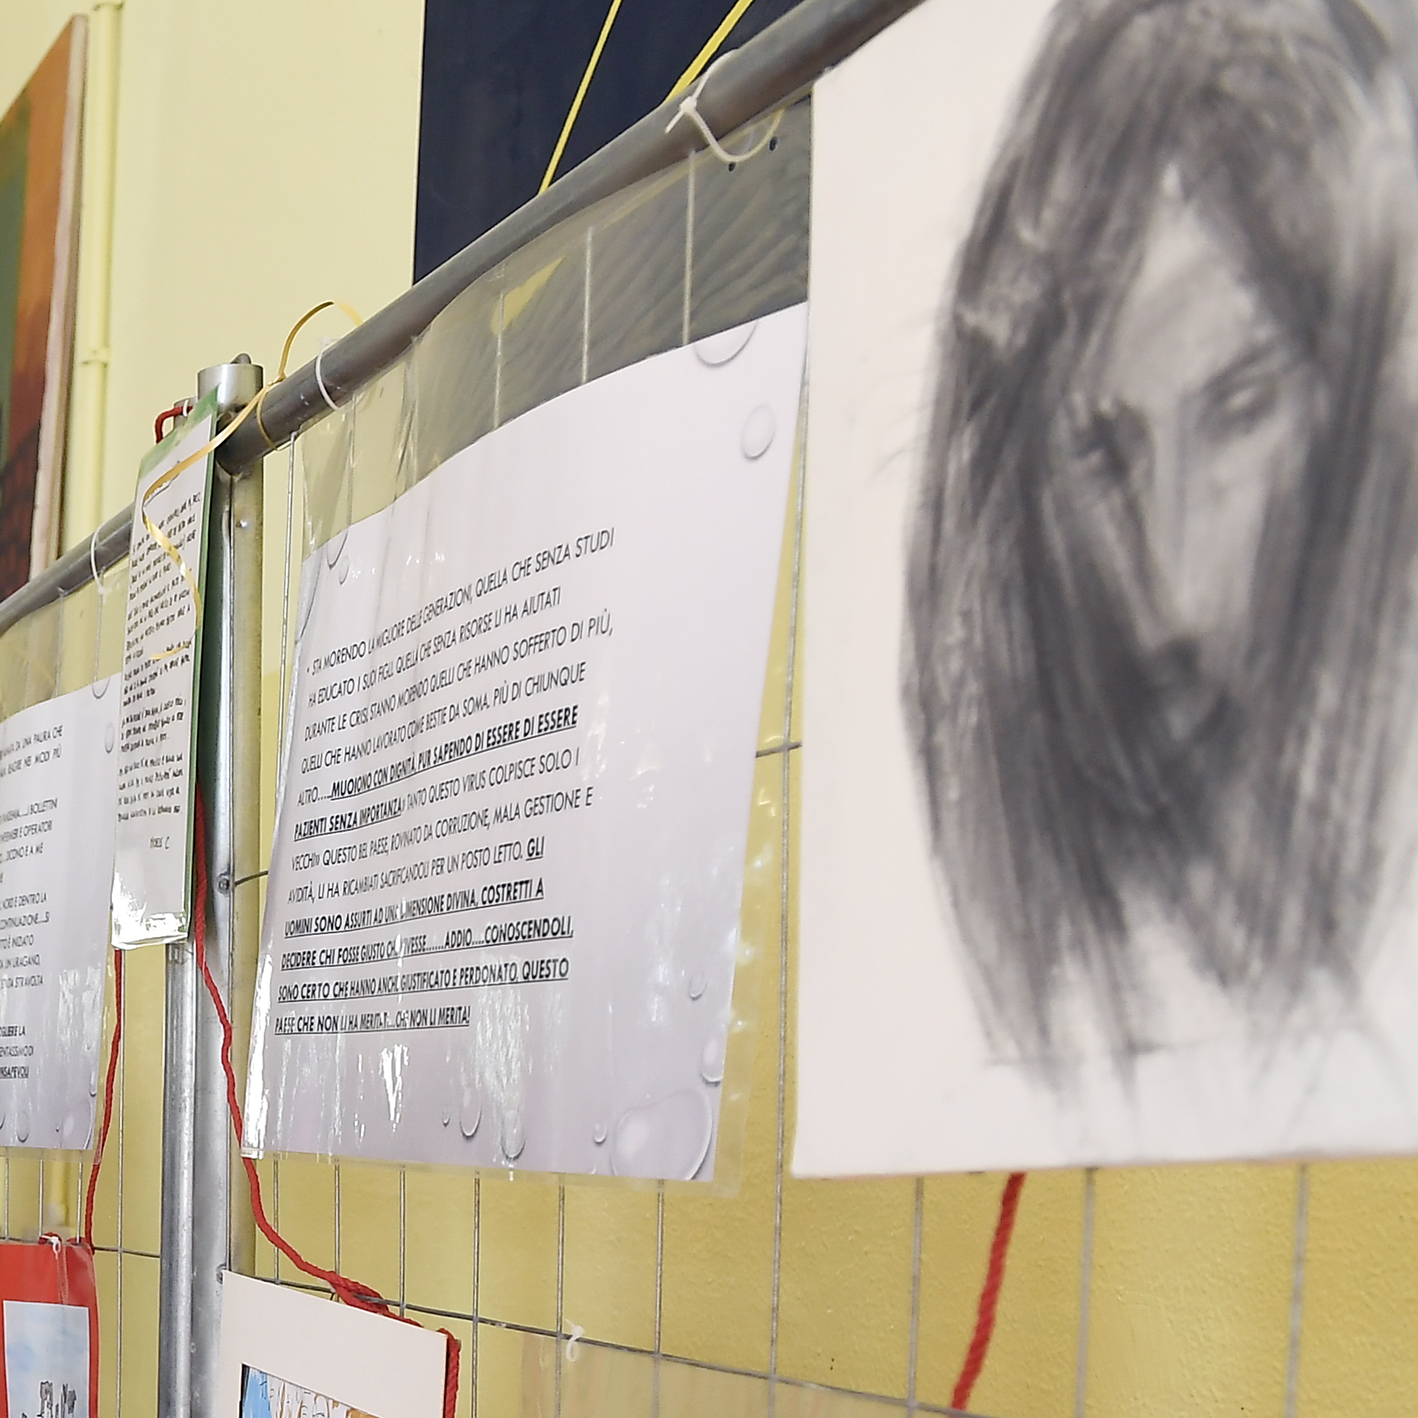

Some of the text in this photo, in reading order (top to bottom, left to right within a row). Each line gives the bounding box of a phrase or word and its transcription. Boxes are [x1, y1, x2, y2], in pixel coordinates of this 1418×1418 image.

[322, 641, 366, 671] MORENDO
[376, 619, 406, 649] MIGLIORE
[475, 567, 508, 597] QUELLA
[511, 556, 533, 582] CHE
[534, 543, 571, 573] SENZA
[574, 527, 615, 558] STUDI
[305, 715, 336, 742] DURANTE
[337, 713, 347, 731] LE
[369, 694, 397, 720] STANNO
[429, 666, 455, 693] QUELLI
[456, 658, 473, 682] CHE
[473, 645, 510, 675] HANNO
[512, 626, 566, 661] SOFFERTO
[570, 620, 584, 643] DI
[587, 608, 614, 638] PIÙ,
[317, 678, 355, 705] EDUCATO
[419, 639, 432, 661] CHE
[433, 629, 457, 654] SENZA
[459, 612, 493, 643] RISORSE
[503, 604, 518, 623] HA
[520, 586, 561, 618] AIUTATI
[300, 753, 323, 775] QUELLI
[323, 748, 342, 767] CHE
[343, 739, 372, 763] HANNO
[372, 725, 407, 753] LAVORATO
[425, 704, 447, 731] BESTIE
[448, 702, 461, 723] DA
[492, 679, 510, 707] PIÙ
[511, 680, 522, 702] DI
[523, 661, 586, 698] CHIUNQUE
[373, 704, 579, 788] CON PUR SAPENDO DI ESSERE DI ESSERE
[294, 816, 327, 839] PAZIENTI
[328, 810, 358, 833] SENZA
[428, 777, 461, 804] QUESTO
[462, 769, 487, 793] VIRUS
[488, 756, 536, 787] COLPISCE
[538, 748, 572, 775] SOLO
[322, 844, 358, 867] QUESTO
[390, 825, 422, 851] ROVINATO
[422, 824, 433, 842] DA
[435, 807, 491, 839] CORRUZIONE,
[492, 802, 521, 826] MALA
[523, 788, 582, 819] GESTIONE
[585, 786, 593, 807] E
[284, 917, 313, 938] UOMINI
[314, 914, 343, 933] SONO
[343, 909, 373, 930] ASSURTI
[373, 907, 383, 925] AD
[481, 878, 533, 905] COSTRETTI
[535, 876, 544, 898] A
[326, 881, 340, 899] HA
[430, 857, 445, 877] PER
[446, 853, 460, 874] UN
[460, 846, 491, 871] POSTO
[526, 836, 545, 860] GLI
[278, 982, 299, 1001] SONO
[300, 982, 331, 1000] CERTO
[332, 981, 349, 998] CHE
[349, 977, 377, 997] HANNO
[452, 967, 457, 986] E
[522, 957, 569, 982] QUESTO
[281, 941, 385, 970] DECIDERE CHI FOSSE GIUSTO
[296, 1015, 315, 1032] CHE
[316, 1014, 340, 1032] NON
[409, 1008, 428, 1027] NON
